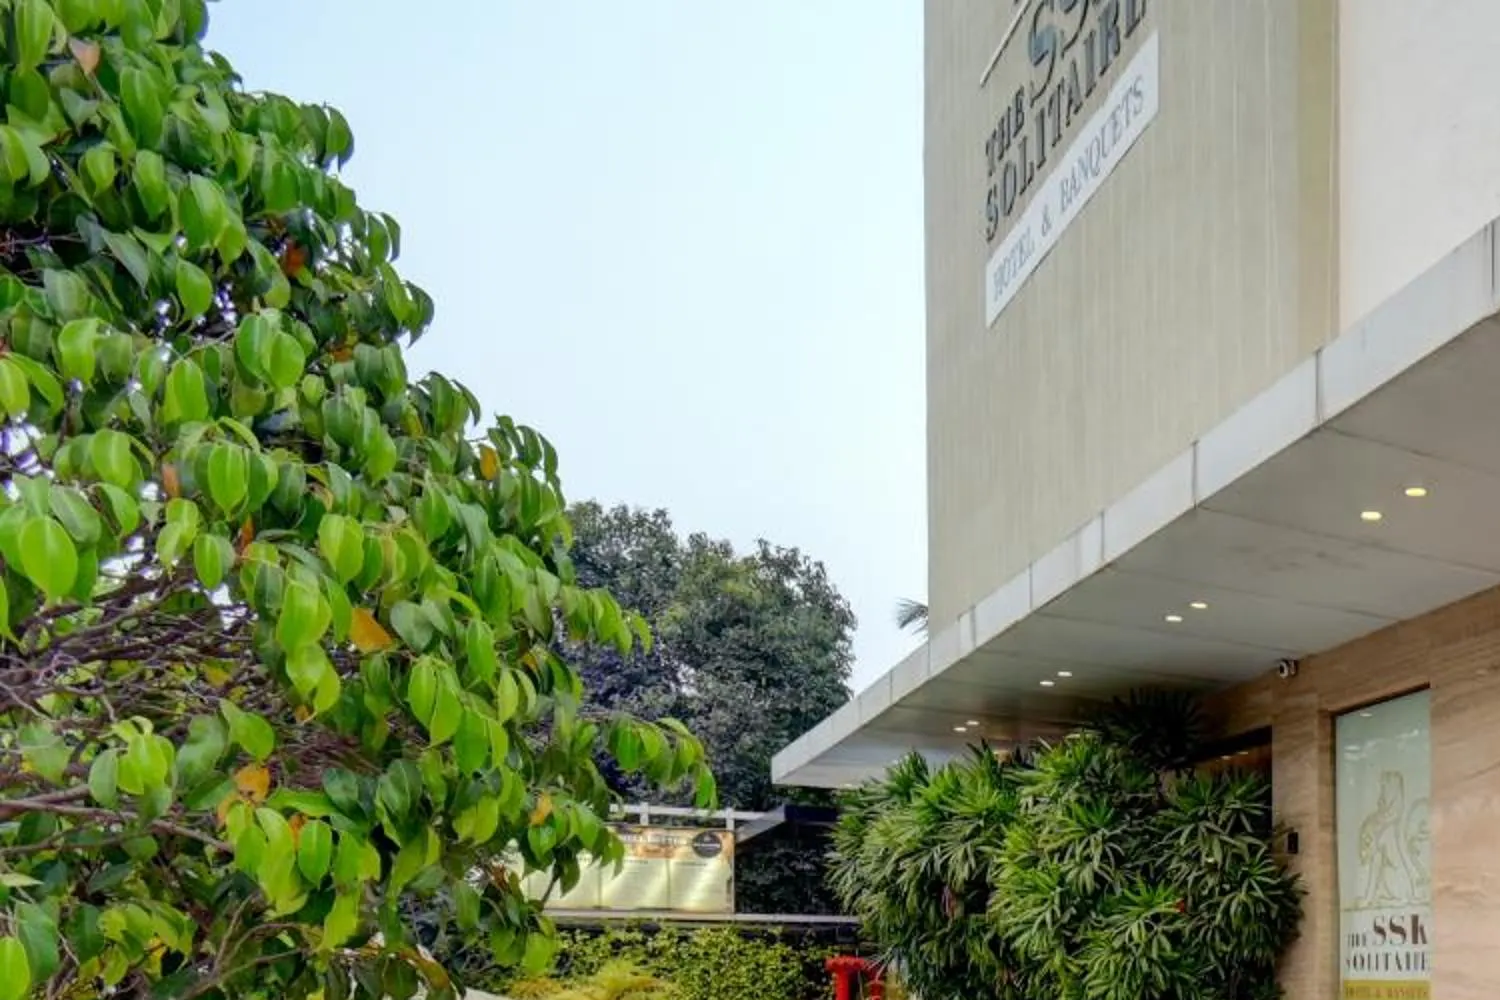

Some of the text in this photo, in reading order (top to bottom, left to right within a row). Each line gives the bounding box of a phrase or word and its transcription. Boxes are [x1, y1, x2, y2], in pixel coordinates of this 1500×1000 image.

[985, 86, 1025, 177] THE
[993, 74, 1146, 301] HOTEL & BANQUETS
[1372, 914, 1429, 945] SSK
